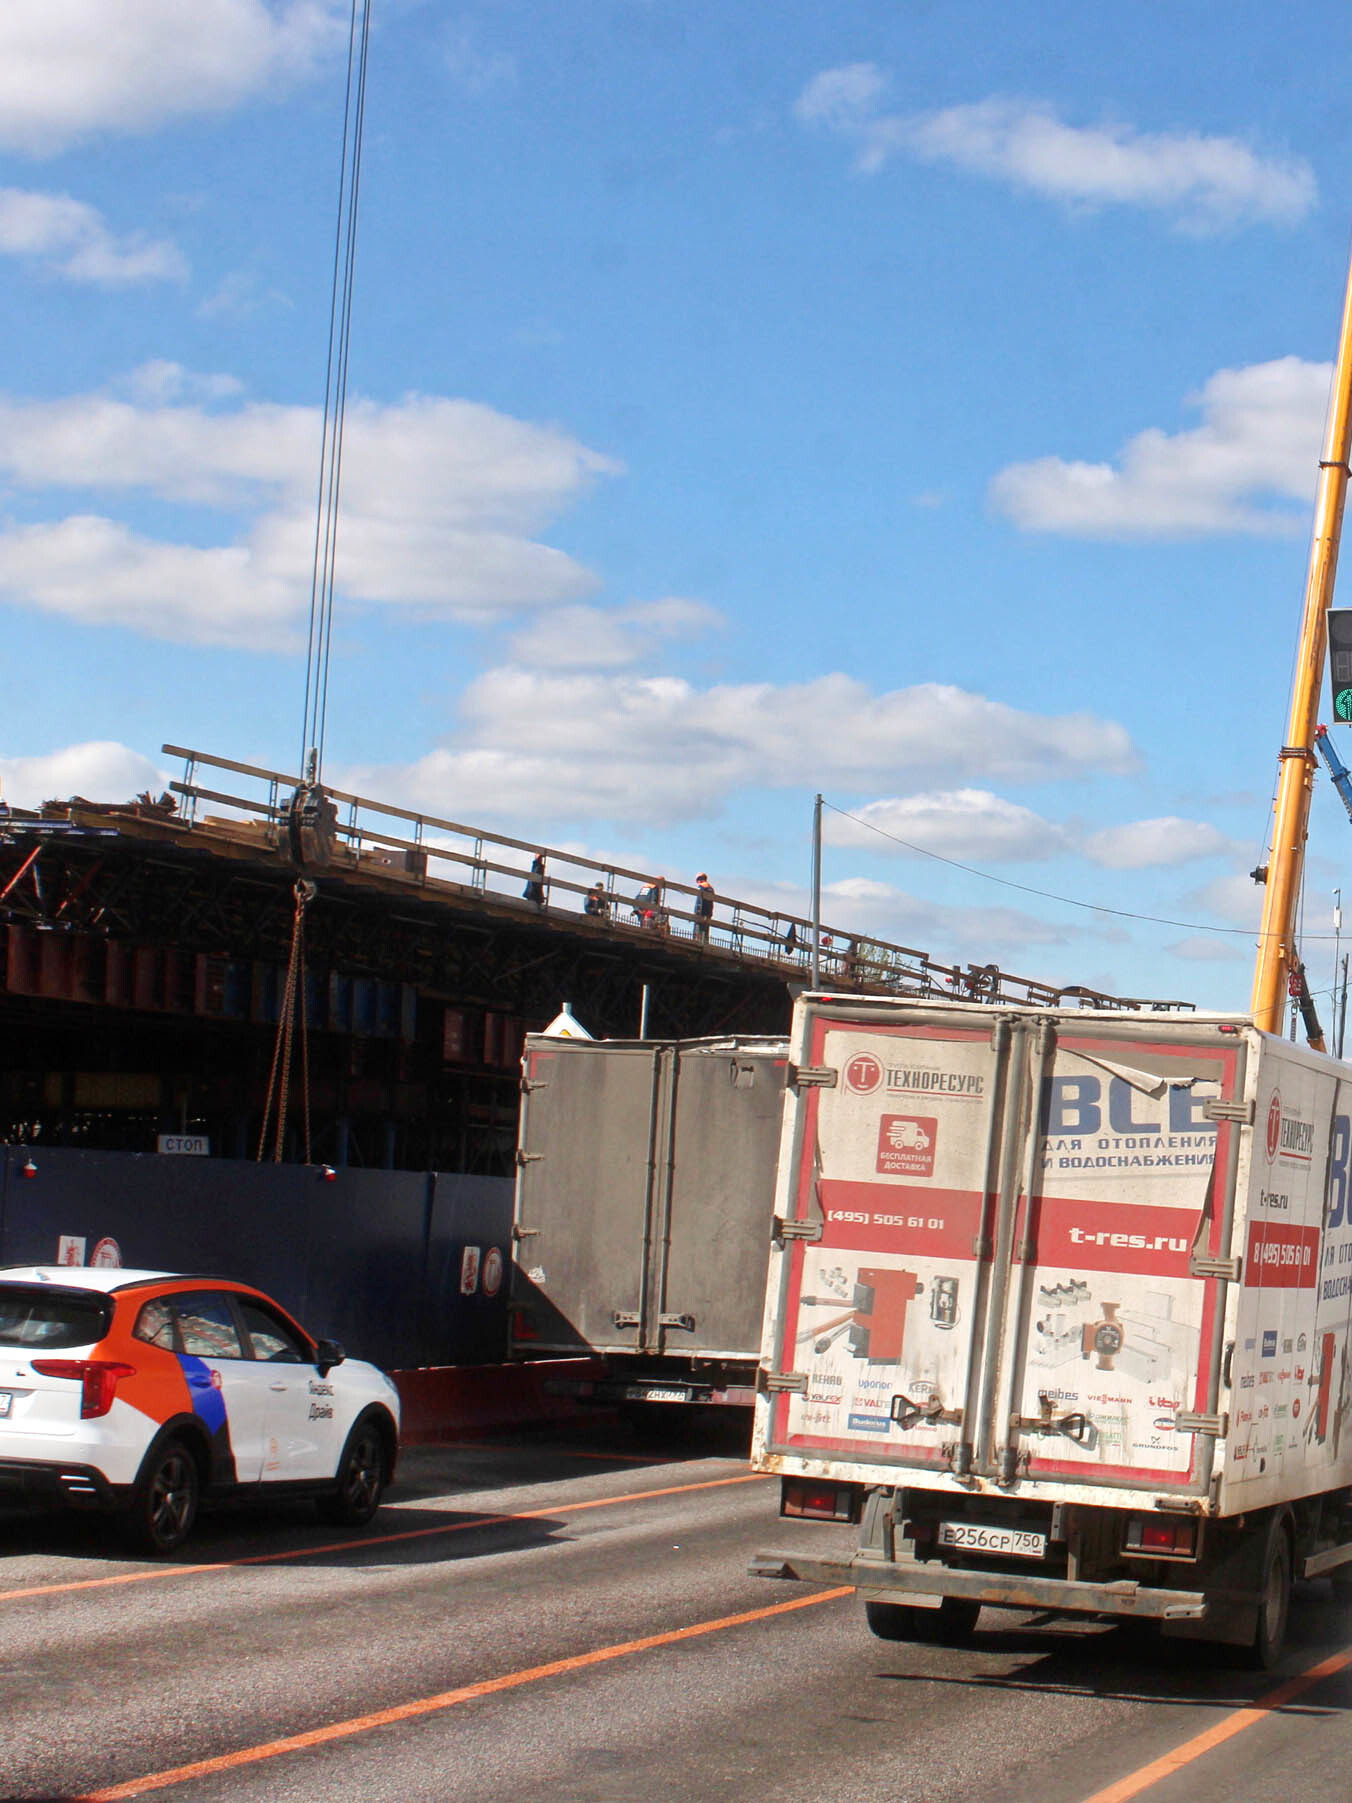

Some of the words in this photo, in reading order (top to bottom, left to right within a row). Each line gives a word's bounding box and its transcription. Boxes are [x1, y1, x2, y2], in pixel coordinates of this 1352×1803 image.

[886, 1069, 985, 1094] ТЕХНОРЕСУРС
[166, 1138, 202, 1151] СТОП
[1098, 1136, 1217, 1150] ОТОПЛЕНИЯ
[884, 1161, 926, 1171] ДОСТАВКА
[873, 1213, 904, 1227] 505
[907, 1217, 924, 1228] 61
[927, 1218, 945, 1230] 01
[1068, 1226, 1188, 1253] t-res.ru
[1253, 1242, 1260, 1264] 8
[1037, 1387, 1079, 1401] meibes
[863, 1398, 892, 1409] VALTE
[943, 1527, 1011, 1549] Е256СР
[1014, 1532, 1040, 1548] 750
